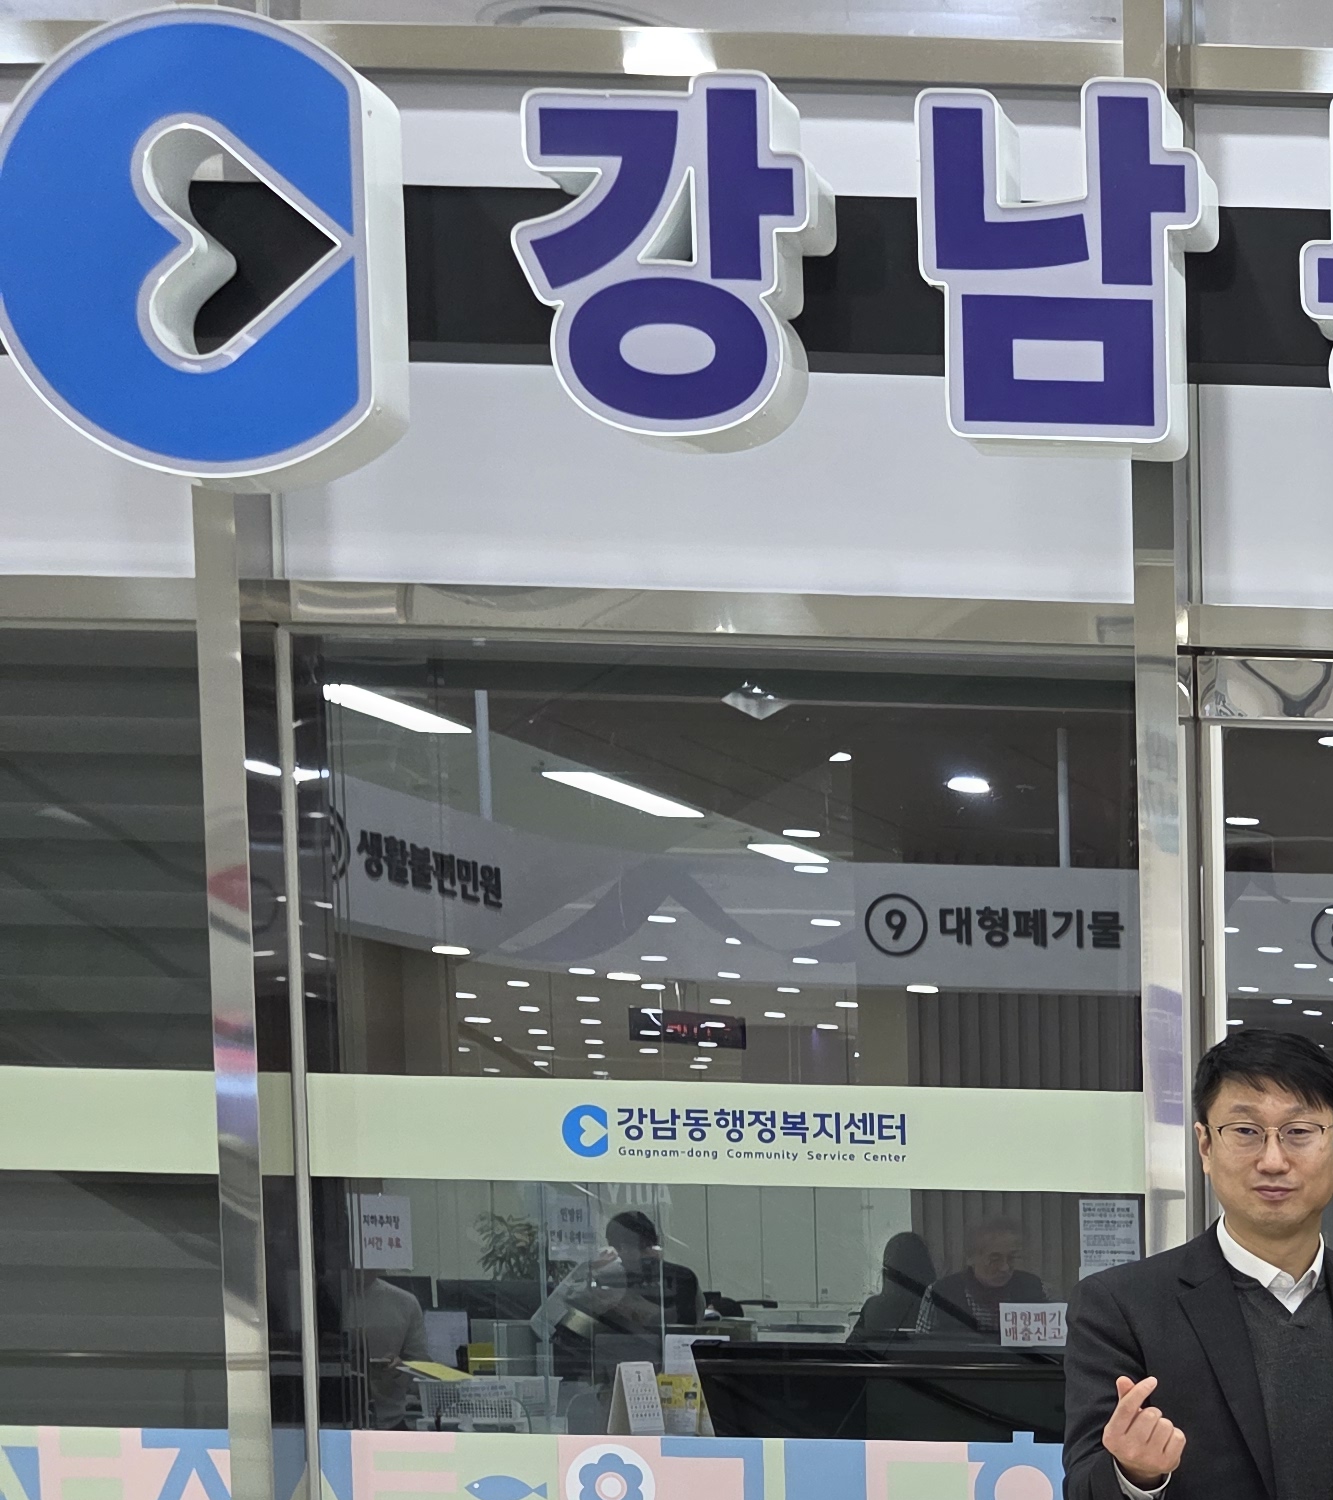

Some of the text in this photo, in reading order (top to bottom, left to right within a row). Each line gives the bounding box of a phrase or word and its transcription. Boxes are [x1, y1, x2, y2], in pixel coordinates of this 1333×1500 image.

[356, 829, 502, 908] 생활불편민원
[939, 906, 1124, 949] 대형폐기물
[617, 1107, 907, 1146] 강남동행정복지센터
[618, 1146, 907, 1163] Gangnam-dong Community Service Center
